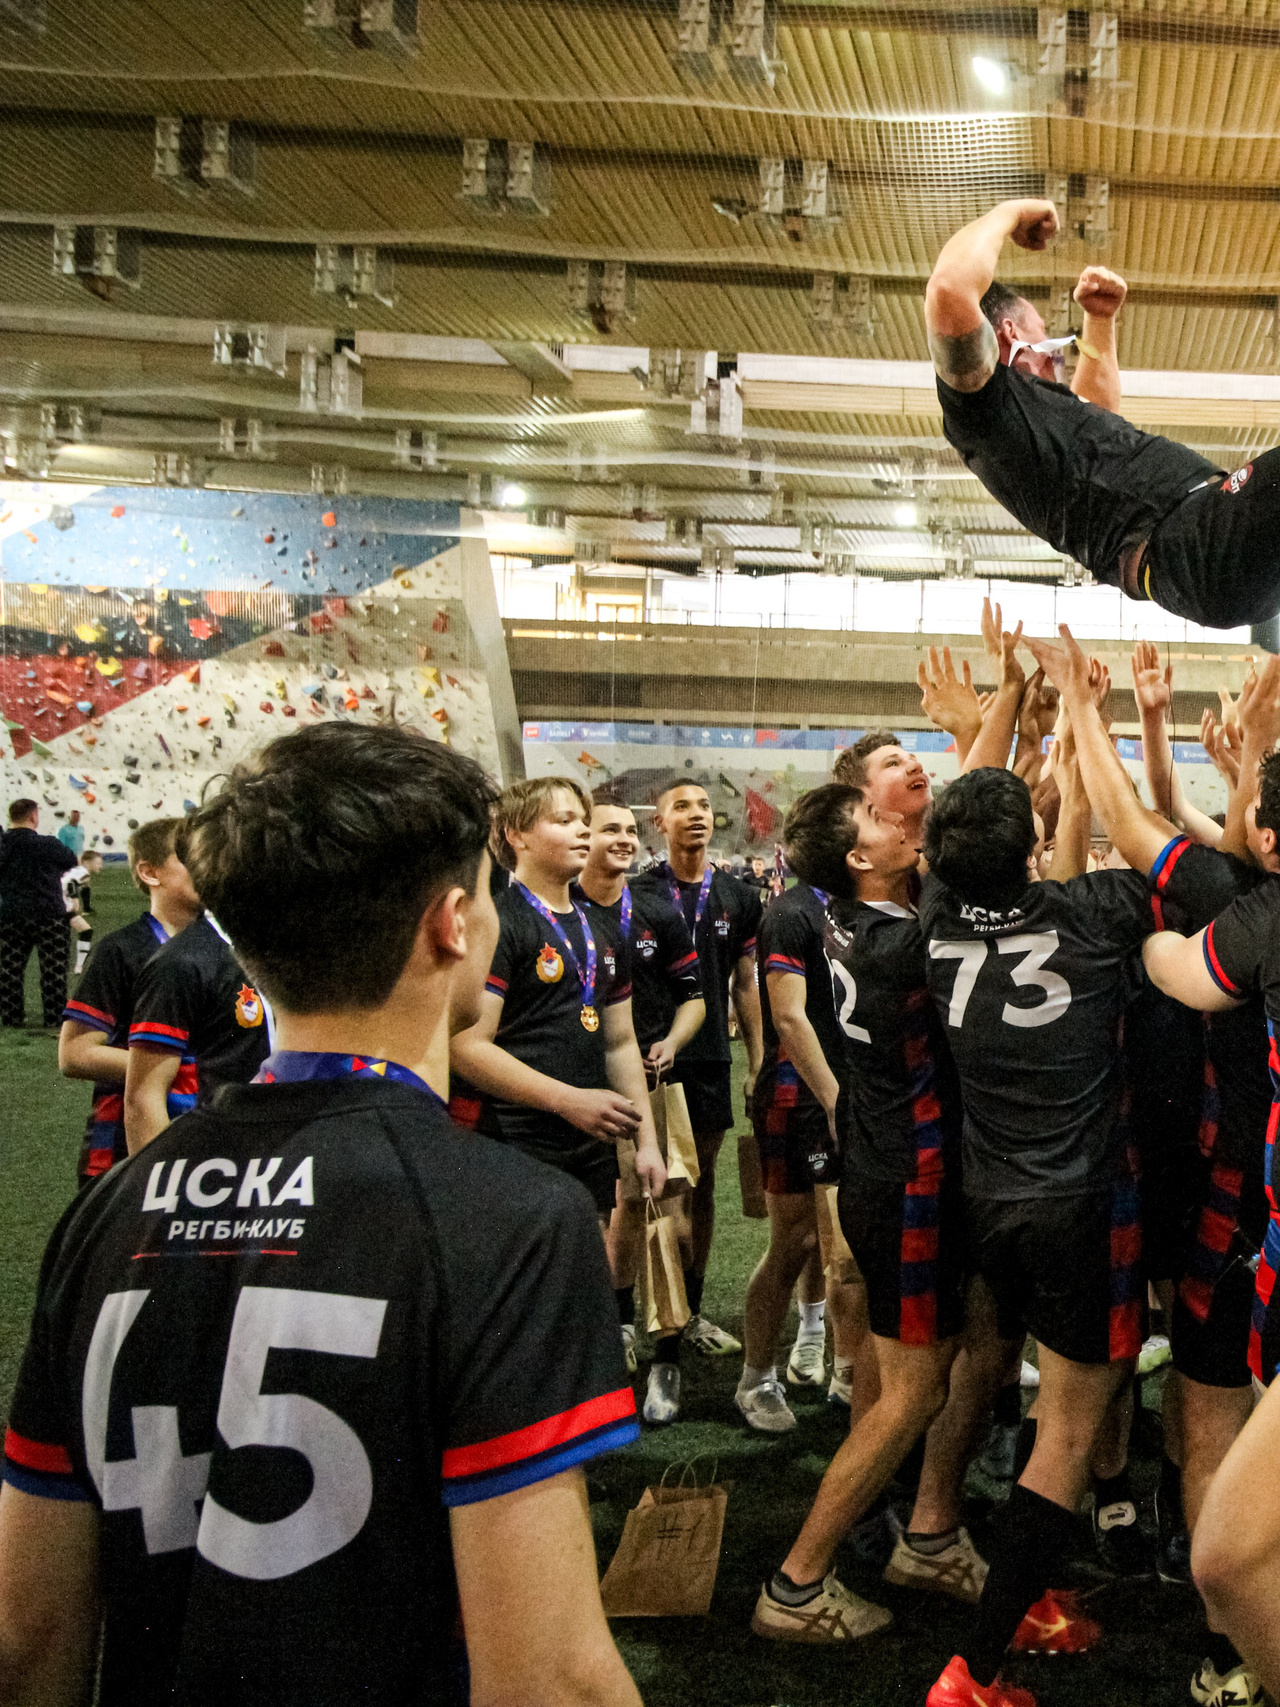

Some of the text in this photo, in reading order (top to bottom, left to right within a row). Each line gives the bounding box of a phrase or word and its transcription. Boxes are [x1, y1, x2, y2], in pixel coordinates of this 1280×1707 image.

[928, 929, 1072, 1028] 73
[142, 1156, 315, 1214] ЦСКА
[168, 1218, 307, 1241] РЕГБИ-КЛУБ
[82, 1286, 389, 1580] 45
